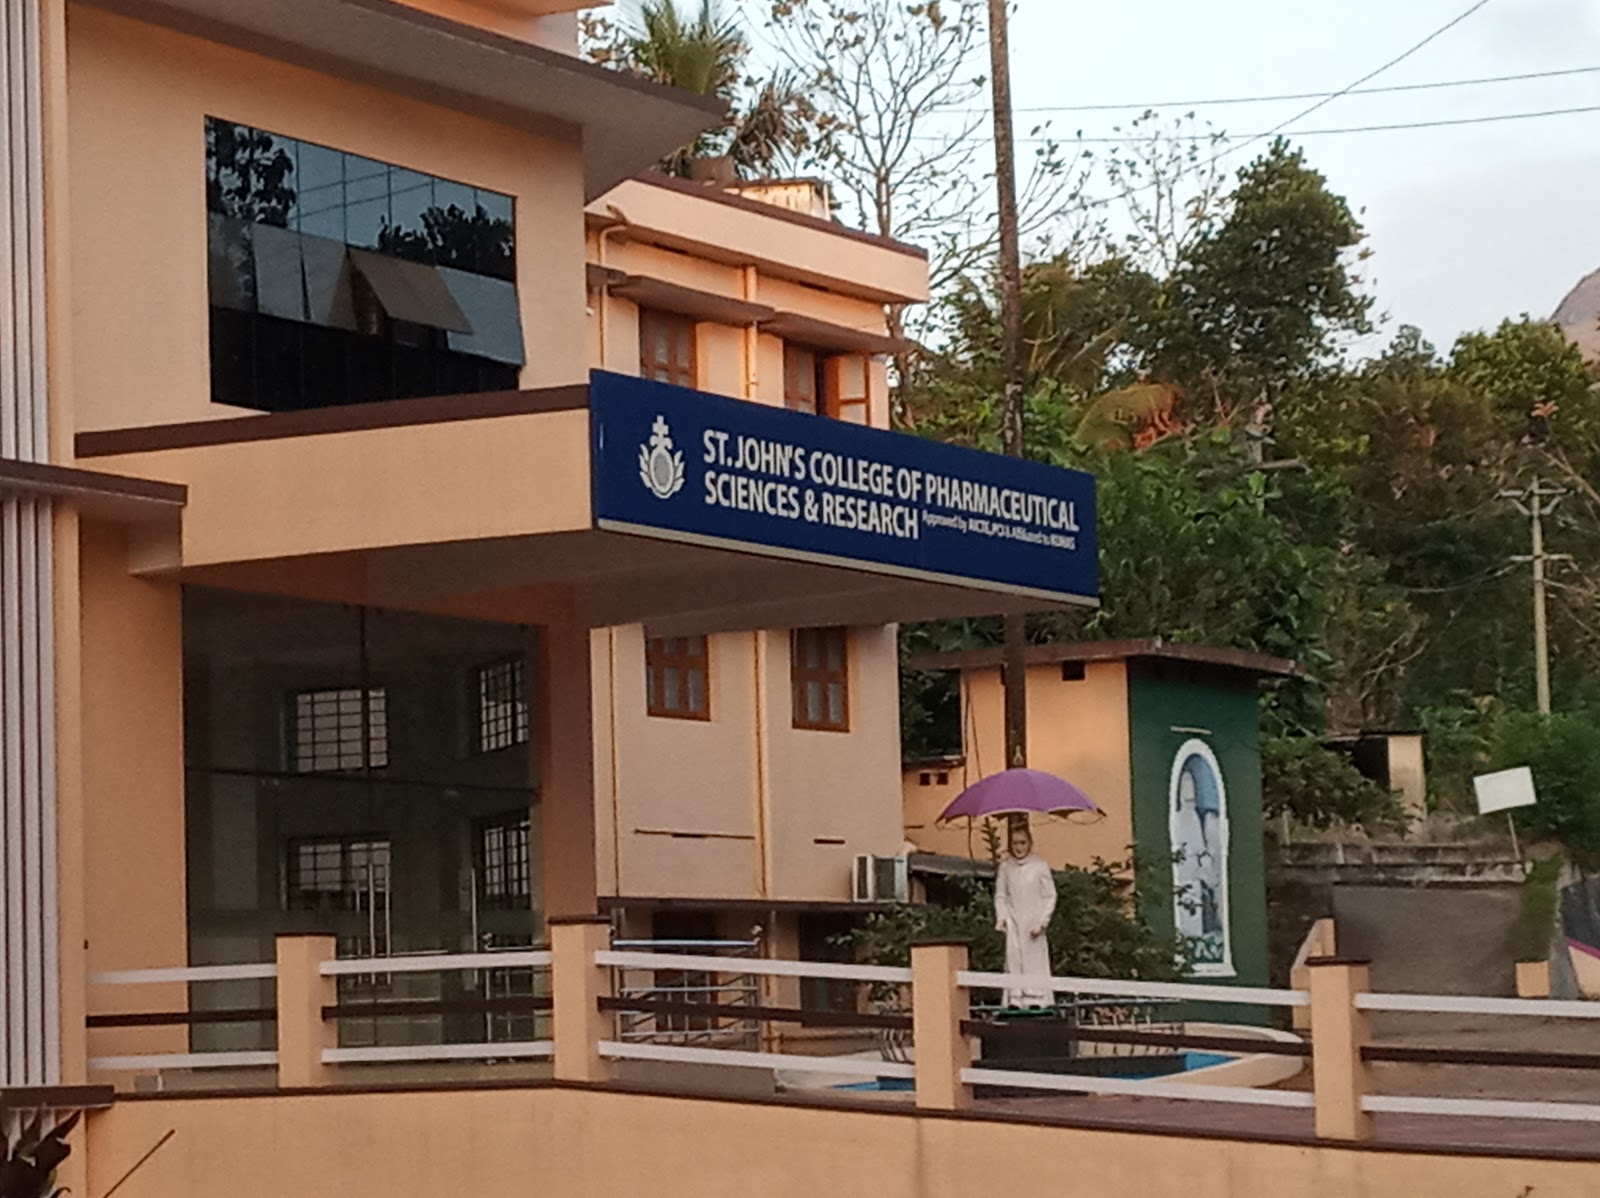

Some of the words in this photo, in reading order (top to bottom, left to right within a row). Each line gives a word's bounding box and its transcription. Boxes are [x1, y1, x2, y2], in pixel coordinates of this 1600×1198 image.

[704, 470, 800, 519] SCIENCES
[804, 488, 819, 522] &
[822, 491, 919, 540] RESEARCH
[809, 451, 894, 497] COLLEGE
[896, 467, 922, 502] OF
[925, 473, 1080, 532] PHARMACEUTICAL
